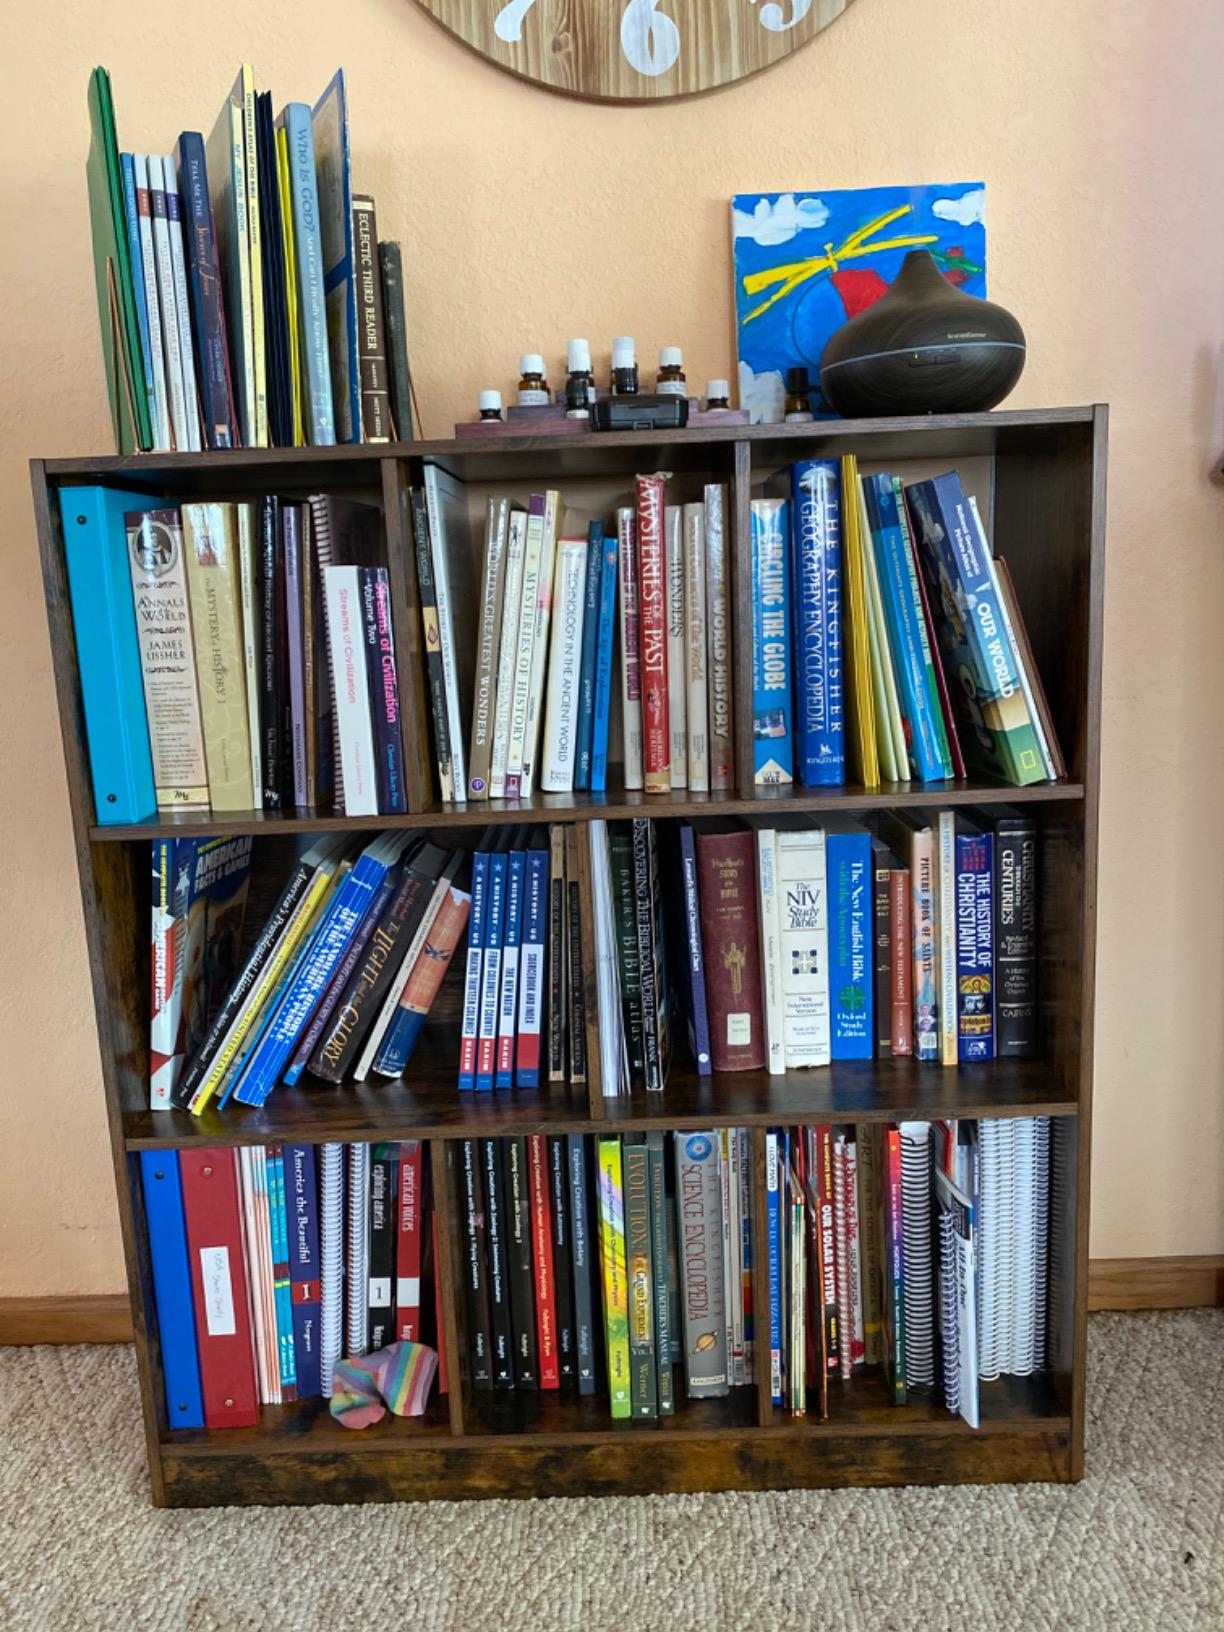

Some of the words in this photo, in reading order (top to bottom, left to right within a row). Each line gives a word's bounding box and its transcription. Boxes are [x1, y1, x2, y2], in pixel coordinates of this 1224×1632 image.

[234, 144, 242, 159] MY
[191, 160, 200, 180] TELL
[235, 164, 243, 197] JESUS
[193, 184, 202, 197] ME
[194, 200, 203, 217] THE
[236, 203, 245, 232] BOOK
[359, 213, 374, 265] ECLECTIC
[362, 269, 376, 303] THIRD
[364, 307, 378, 349] READER
[416, 508, 428, 548] ANCIENT
[639, 478, 664, 600] MYSTERIES
[826, 500, 838, 549] THE
[418, 550, 430, 586] WORLD
[760, 533, 784, 606] CIRCLING
[800, 500, 822, 608] GEOGRAPHY
[138, 596, 185, 608] ANNALS
[141, 610, 186, 622] WORLD
[205, 588, 220, 639] MYSTERY
[339, 588, 352, 632] Streams
[363, 584, 376, 621] Volume
[375, 581, 392, 634] Streams
[519, 572, 536, 654] MYSTERIES
[564, 568, 580, 642] TECHNOLOGY
[644, 606, 652, 624] THE
[652, 606, 662, 620] OF
[366, 624, 378, 644] Two
[714, 600, 727, 660] WORLD
[762, 610, 785, 638] THE
[976, 602, 998, 638] OUR
[148, 640, 183, 650] JAMES
[342, 635, 353, 644] of
[379, 638, 393, 652] of
[479, 606, 494, 671] GREATEST
[563, 644, 576, 658] IN
[645, 629, 664, 676] PAST
[827, 569, 842, 732] KINGFISHER
[146, 650, 186, 660] USSHER
[518, 658, 530, 674] OF
[562, 660, 575, 676] THE
[763, 642, 786, 690] GLOBE
[985, 638, 1014, 698] WORLD
[212, 648, 226, 696] HISTORY
[343, 647, 358, 704] Civilization
[803, 610, 824, 733] ENCYCLOPEDIA
[381, 655, 399, 722] Civilization
[560, 679, 574, 724] ANCIENT
[715, 666, 728, 738] HISTORY
[474, 676, 490, 745] WONDERS
[512, 681, 528, 744] HISTORY
[558, 726, 572, 762] WORLD
[634, 819, 649, 896] DISCOVERING
[851, 860, 864, 884] The
[796, 882, 810, 890] The
[920, 857, 930, 893] PICTURE
[977, 872, 990, 898] THE
[1002, 850, 1014, 924] CENTURIES
[1022, 840, 1034, 932] CHRISTIANITY
[280, 868, 308, 916] America's
[472, 884, 482, 924] HISTORY
[530, 880, 538, 920] HISTORY
[620, 869, 634, 928] BAKER'S
[786, 890, 820, 906] NIV
[851, 886, 864, 908] New
[636, 900, 650, 922] THE
[788, 905, 819, 918] Study
[790, 917, 817, 928] Bible
[921, 899, 931, 922] BOOK
[958, 872, 977, 968] CHRISTIANITY
[977, 900, 991, 948] HISTORY
[472, 933, 480, 945] US
[529, 928, 537, 940] US
[851, 910, 864, 951] English
[922, 926, 932, 936] OF
[311, 931, 348, 991] LANDMARK
[361, 928, 396, 988] LIGHT
[468, 951, 478, 975] MAKING
[487, 951, 498, 969] FROM
[637, 924, 652, 972] BIBLICAL
[922, 942, 933, 972] SAINTS
[978, 952, 992, 967] OF
[525, 954, 537, 990] SOURCEBOOK
[624, 936, 641, 994] BIBLE
[851, 954, 864, 982] Bible
[466, 978, 477, 1004] THIRTEEN
[485, 970, 497, 998] COLONIES
[504, 980, 515, 994] NEW
[525, 992, 536, 1005] AND
[639, 974, 654, 1016] WORLD
[275, 1000, 301, 1041] PEOPLE
[286, 992, 316, 1037] HISTORY
[464, 1006, 476, 1036] COLONIES
[503, 994, 514, 1016] NATION
[524, 1006, 535, 1024] INDEX
[836, 1012, 866, 1020] Oxford
[1002, 1008, 1032, 1018] CAIRNS
[322, 1004, 359, 1068] GLORY
[484, 1008, 496, 1036] COUNTRY
[630, 1002, 642, 1042] atlas
[836, 1029, 866, 1037] Edition
[840, 1022, 863, 1030] Study
[532, 1136, 540, 1163] Exploring
[294, 1150, 306, 1194] America
[373, 1164, 386, 1199] exploring
[533, 1164, 542, 1190] Creation
[573, 1148, 582, 1186] Exploring
[606, 1164, 614, 1194] Exploring
[402, 1164, 414, 1204] american
[535, 1190, 543, 1204] with
[682, 1164, 704, 1218] SCIENCE
[296, 1196, 307, 1214] the
[373, 1200, 386, 1229] america
[535, 1206, 544, 1227] Human
[574, 1187, 583, 1218] Creation
[608, 1196, 616, 1222] Creation
[628, 1153, 649, 1249] EVOLUTION:
[822, 1204, 833, 1228] OUR
[402, 1206, 414, 1232] voices
[575, 1219, 584, 1238] with
[297, 1216, 310, 1264] Beautiful
[536, 1228, 545, 1255] Anatomy
[575, 1240, 585, 1266] Botany
[609, 1239, 618, 1271] Chemistry
[822, 1230, 834, 1264] SOLAR
[685, 1224, 708, 1321] ENCYCLOPEDIA
[709, 1208, 721, 1318] KINGFISHER
[376, 1286, 382, 1300] 1
[538, 1268, 548, 1300] Physiology
[611, 1284, 620, 1306] Physics
[823, 1266, 836, 1304] SYSTEM
[658, 1284, 668, 1328] TEACHER'S
[580, 1326, 589, 1355] Fulbright
[659, 1329, 669, 1366] MANUAL
[615, 1350, 624, 1378] Fulbright
[639, 1363, 650, 1398] Werner
